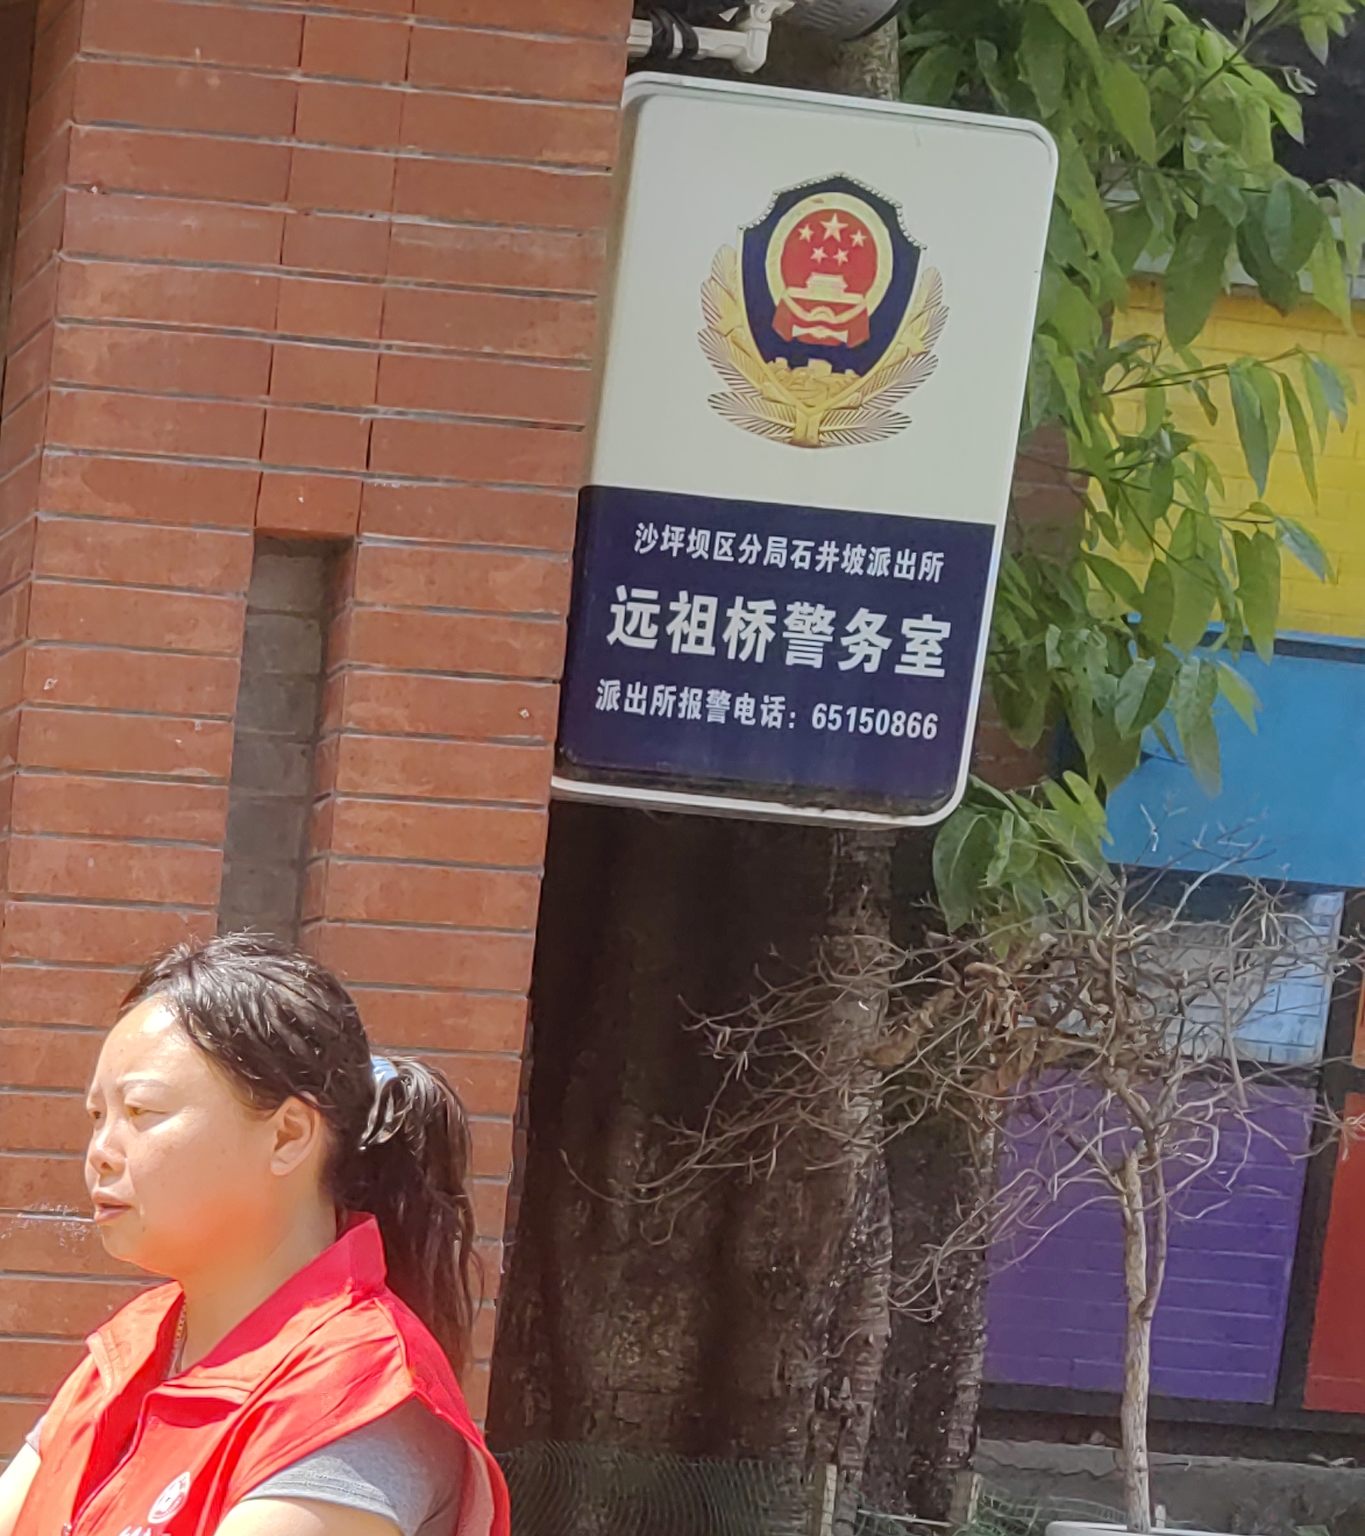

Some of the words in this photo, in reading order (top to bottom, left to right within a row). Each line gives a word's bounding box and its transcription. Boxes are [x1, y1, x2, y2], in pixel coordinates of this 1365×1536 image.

[634, 522, 945, 584] 沙坪坝区分局石井坡派出所
[606, 584, 952, 678] 远祖桥警务室
